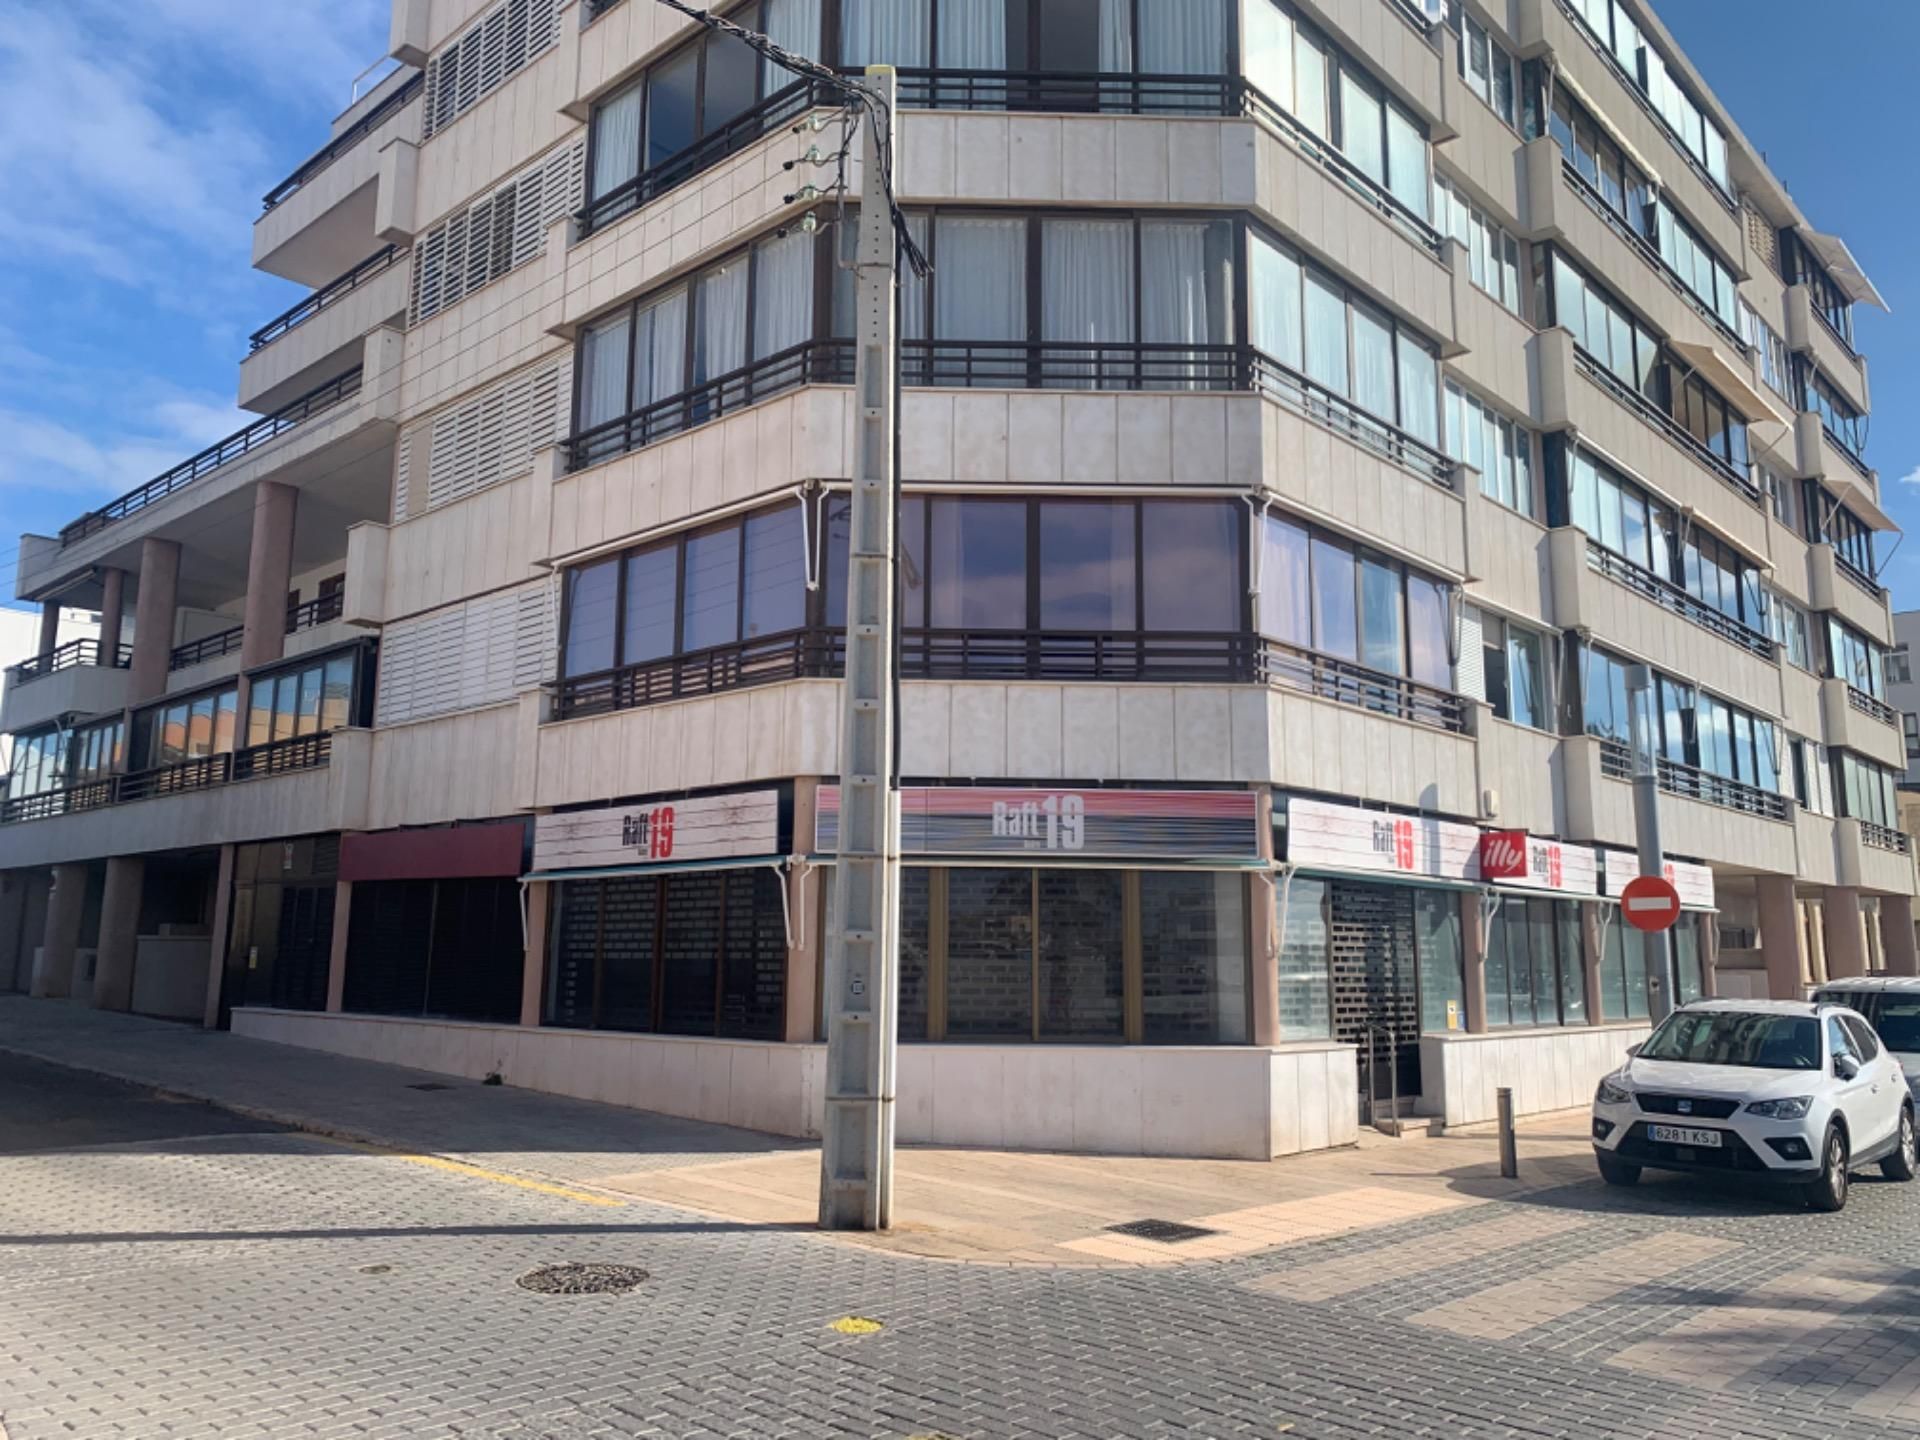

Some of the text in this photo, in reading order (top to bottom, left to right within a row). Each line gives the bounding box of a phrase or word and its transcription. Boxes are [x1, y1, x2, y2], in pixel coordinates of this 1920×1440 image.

[622, 807, 673, 859] Raft 19
[992, 794, 1085, 849] Raft 19
[1373, 820, 1413, 869] Raft 19
[1483, 839, 1523, 873] illy
[1548, 846, 1561, 887] 19
[1656, 1127, 1719, 1145] 6281 KSJ
